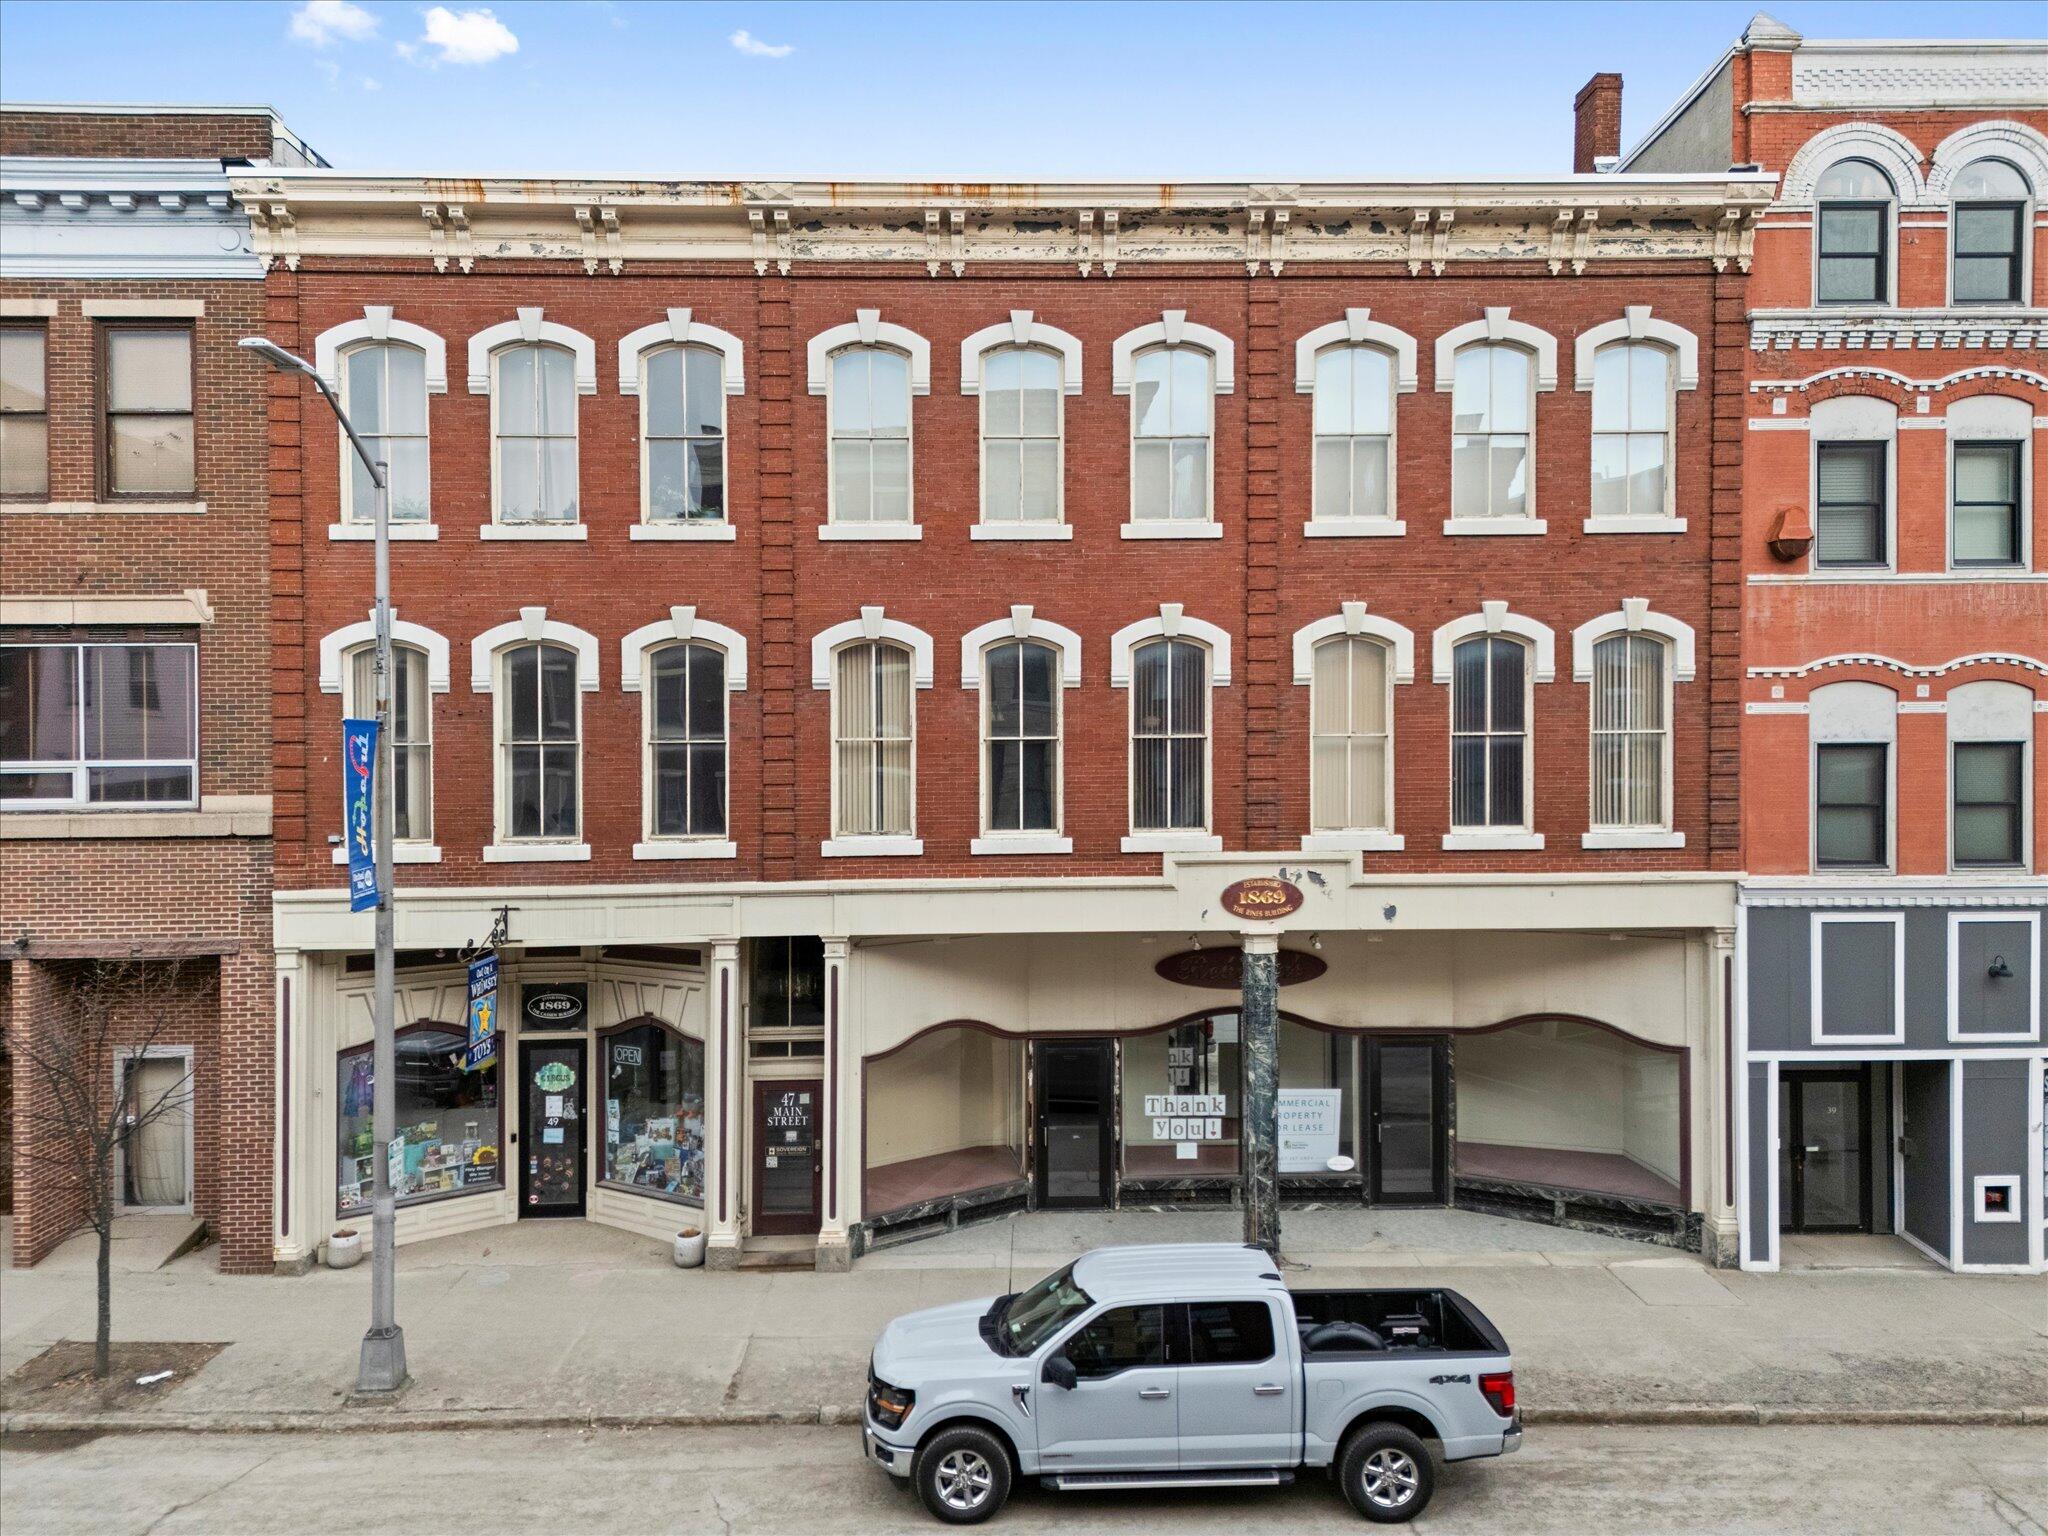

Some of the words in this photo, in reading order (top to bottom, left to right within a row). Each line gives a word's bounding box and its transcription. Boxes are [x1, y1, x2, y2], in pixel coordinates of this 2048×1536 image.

[1239, 890, 1287, 904] 1869
[1232, 905, 1244, 914] THE
[1264, 905, 1293, 917] BUILDING
[540, 1001, 571, 1010] 1869
[473, 1039, 491, 1061] TOYS
[616, 1048, 641, 1063] OPEN
[781, 1092, 795, 1107] 47
[1146, 1097, 1223, 1113] Thank
[1278, 1099, 1331, 1107] MMERCIAL
[773, 1107, 803, 1117] MAIN
[1277, 1112, 1324, 1120] ROPERTY
[547, 1117, 559, 1126] 49
[767, 1116, 809, 1126] STREET
[1156, 1121, 1217, 1137] you!
[1293, 1124, 1325, 1132] LEASE
